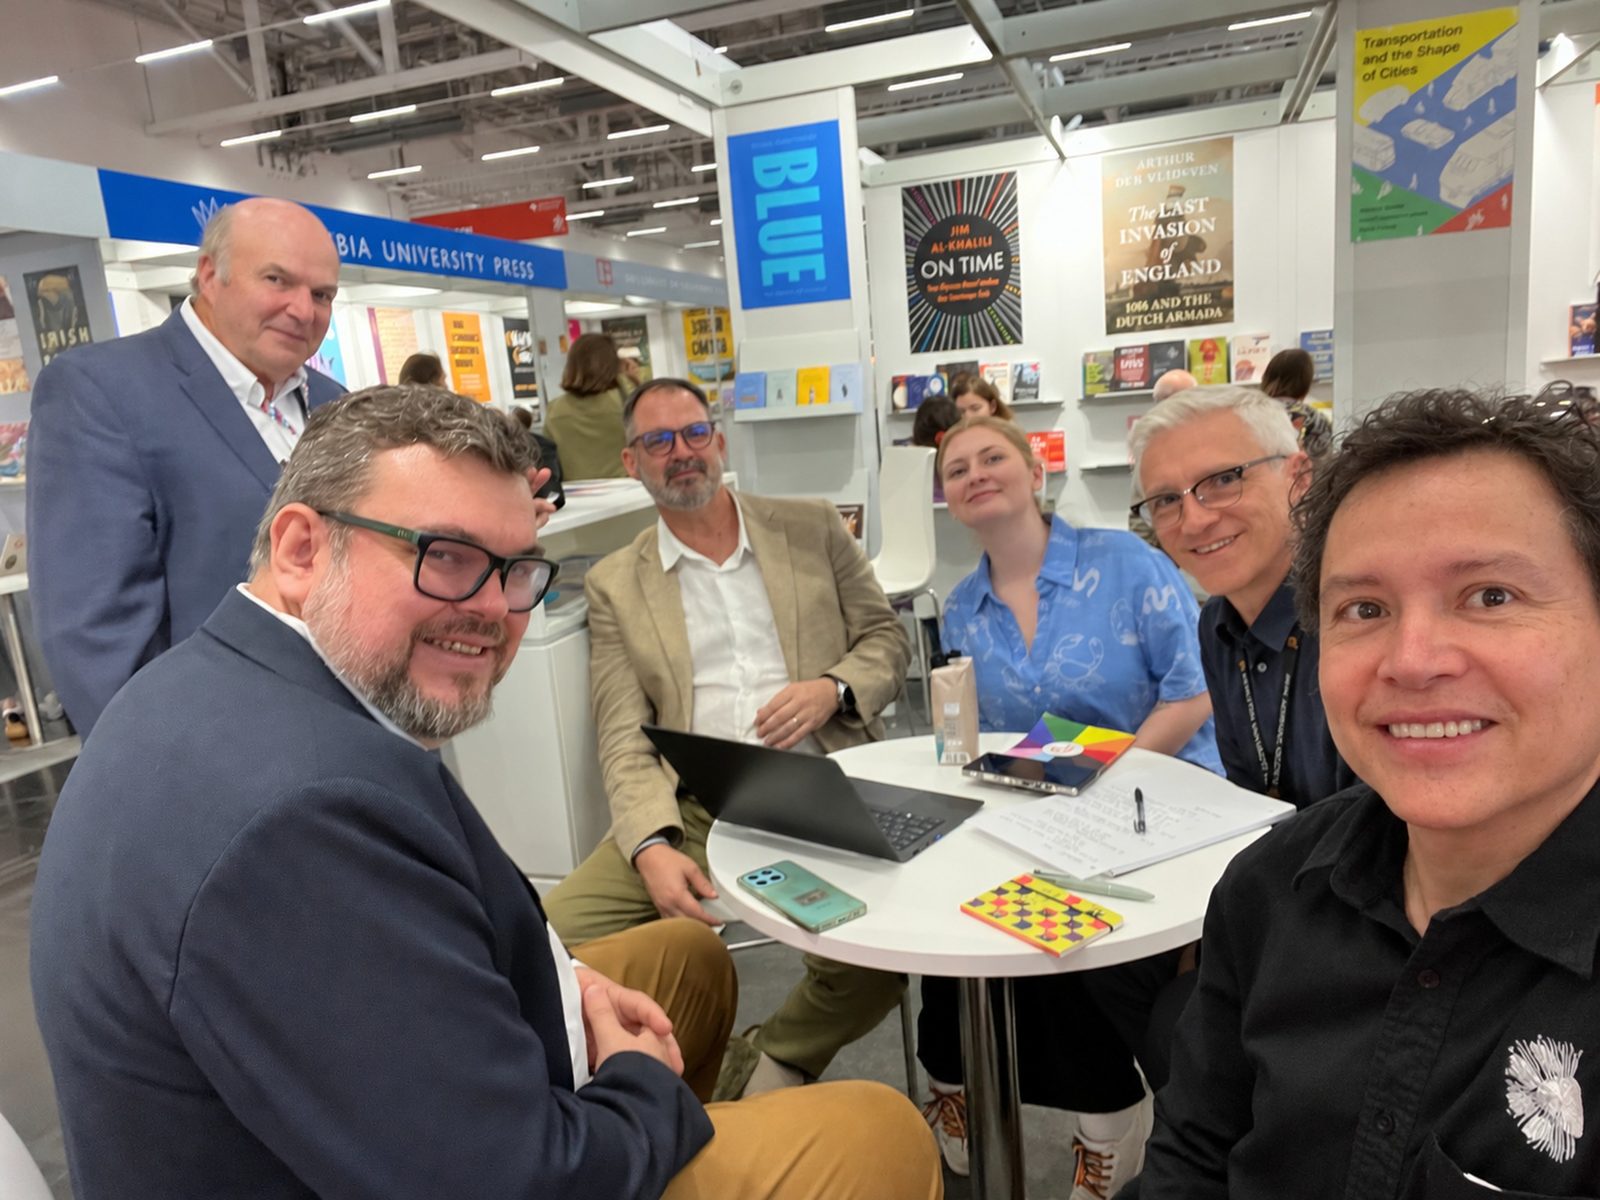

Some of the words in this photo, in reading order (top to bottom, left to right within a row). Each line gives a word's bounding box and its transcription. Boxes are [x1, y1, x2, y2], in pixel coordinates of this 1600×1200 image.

[1363, 26, 1463, 49] Transportation
[1362, 51, 1388, 66] and
[1392, 49, 1413, 61] the
[1417, 43, 1460, 58] Shape
[1362, 69, 1376, 82] of
[1380, 65, 1418, 80] Cities
[1136, 151, 1195, 170] ARTHUR
[752, 146, 827, 287] BLUE
[1128, 204, 1156, 223] The
[1158, 197, 1209, 219] LAST
[950, 223, 970, 238] JIM
[1119, 216, 1217, 245] INVASION
[931, 235, 993, 255] AL-KHALILI
[1159, 241, 1178, 264] of
[381, 239, 485, 274] UNIVERSITY
[493, 256, 535, 280] PRESS
[920, 258, 955, 279] ON
[958, 251, 1005, 275] TIME
[1120, 258, 1222, 290] ENGLAND
[1151, 296, 1181, 311] AND
[1183, 292, 1213, 307] THE
[1115, 311, 1163, 329] DUTCH
[1165, 306, 1223, 324] ARMADA
[40, 325, 90, 350] IRISH
